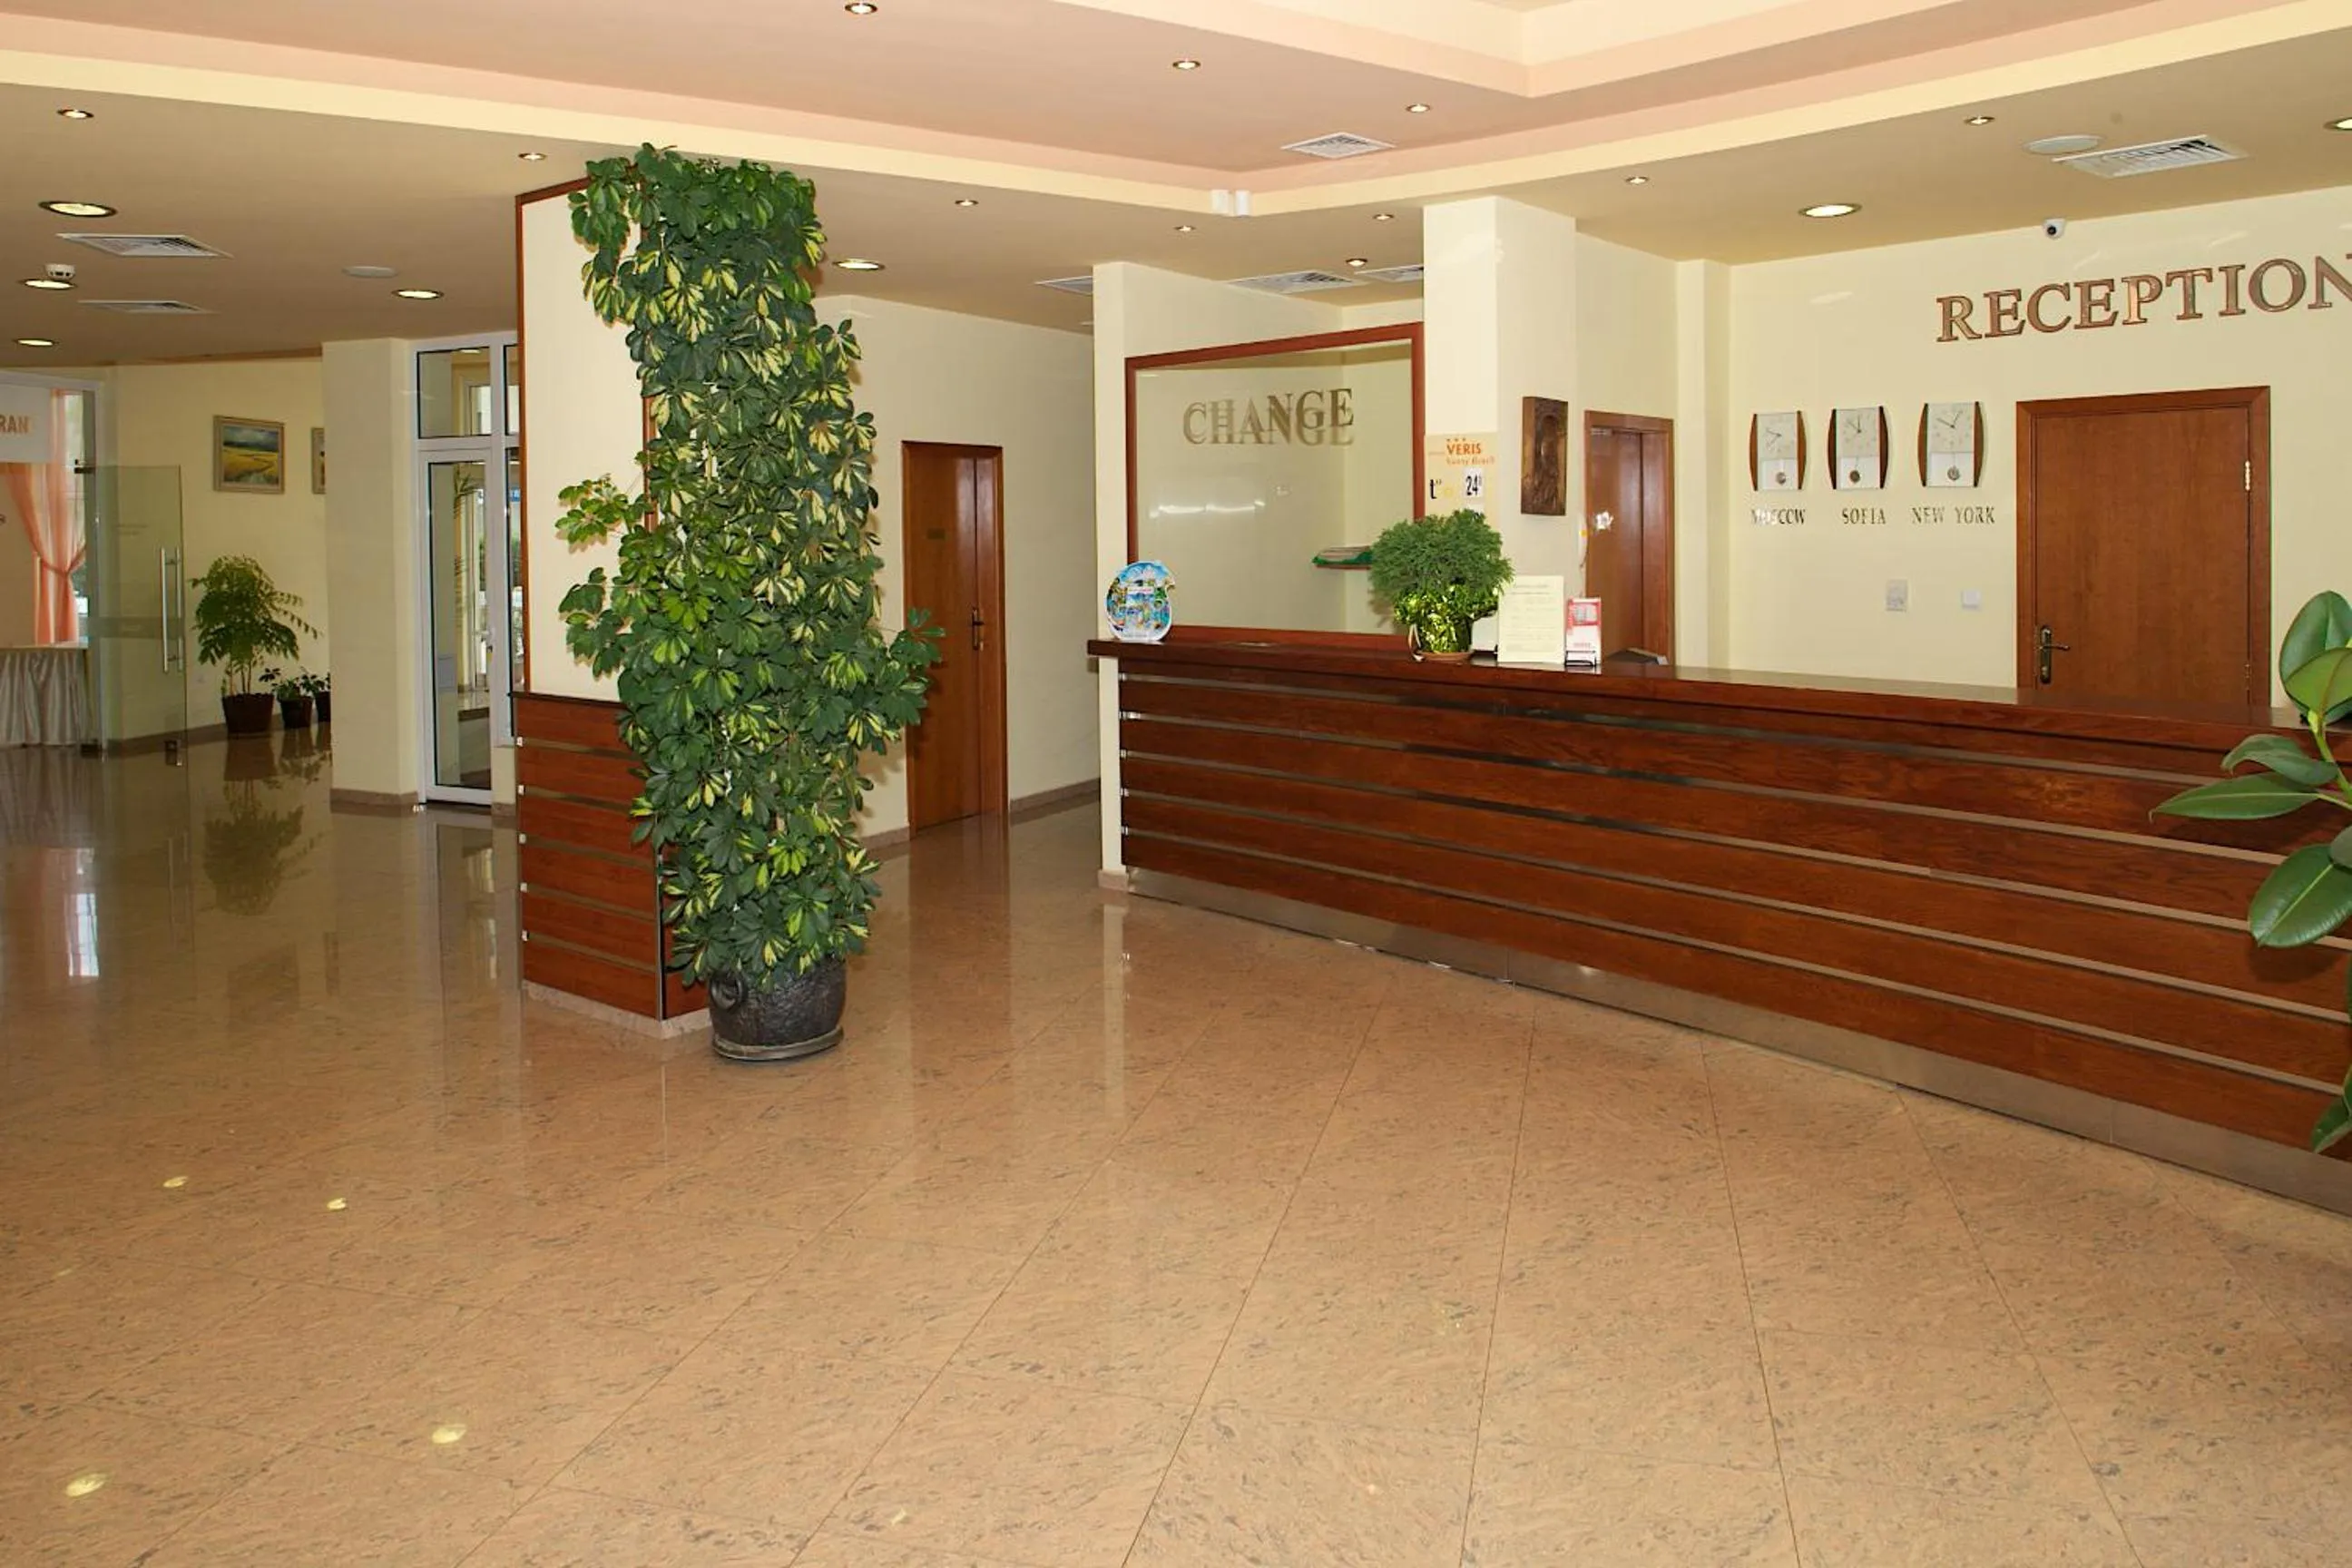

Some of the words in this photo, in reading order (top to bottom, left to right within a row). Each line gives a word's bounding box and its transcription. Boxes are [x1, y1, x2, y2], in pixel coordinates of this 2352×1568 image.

[1936, 254, 2352, 342] RECEPTION
[1182, 387, 1355, 446] CHANGE
[1446, 443, 1481, 455] VERIS
[1841, 508, 1886, 524] SOFIA
[1911, 506, 1945, 524] NEW
[1954, 505, 1995, 524] YORK
